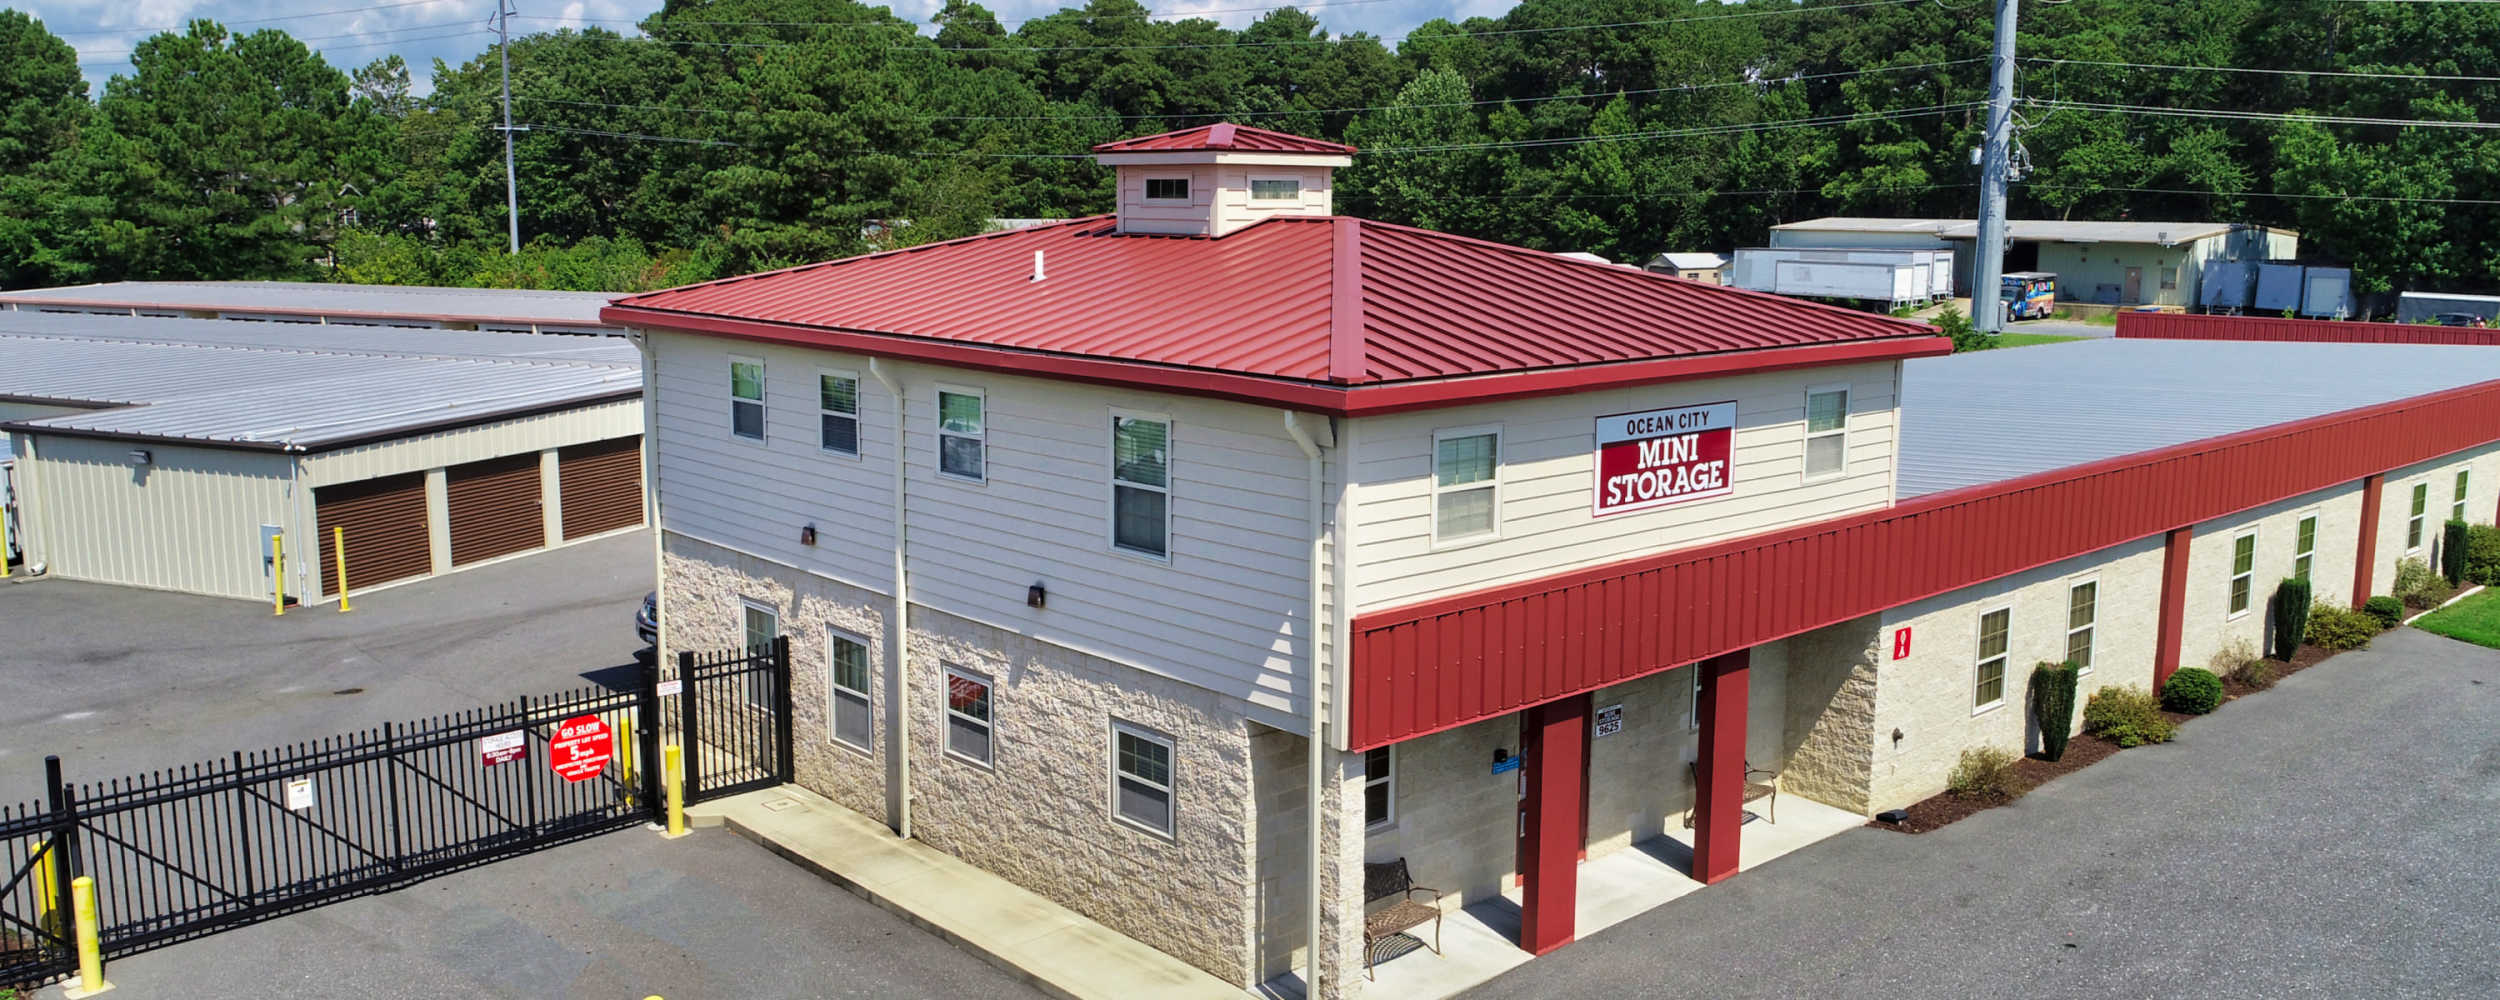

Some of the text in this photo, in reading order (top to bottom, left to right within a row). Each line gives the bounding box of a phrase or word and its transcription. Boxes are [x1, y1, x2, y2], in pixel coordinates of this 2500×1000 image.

[1627, 410, 1710, 436] OCEAN CITY
[1637, 434, 1699, 470] MINI
[1607, 460, 1724, 506] STORAGE
[561, 722, 600, 738] GO SLOW
[1599, 721, 1619, 735] 9625
[570, 745, 594, 760] 5 mph
